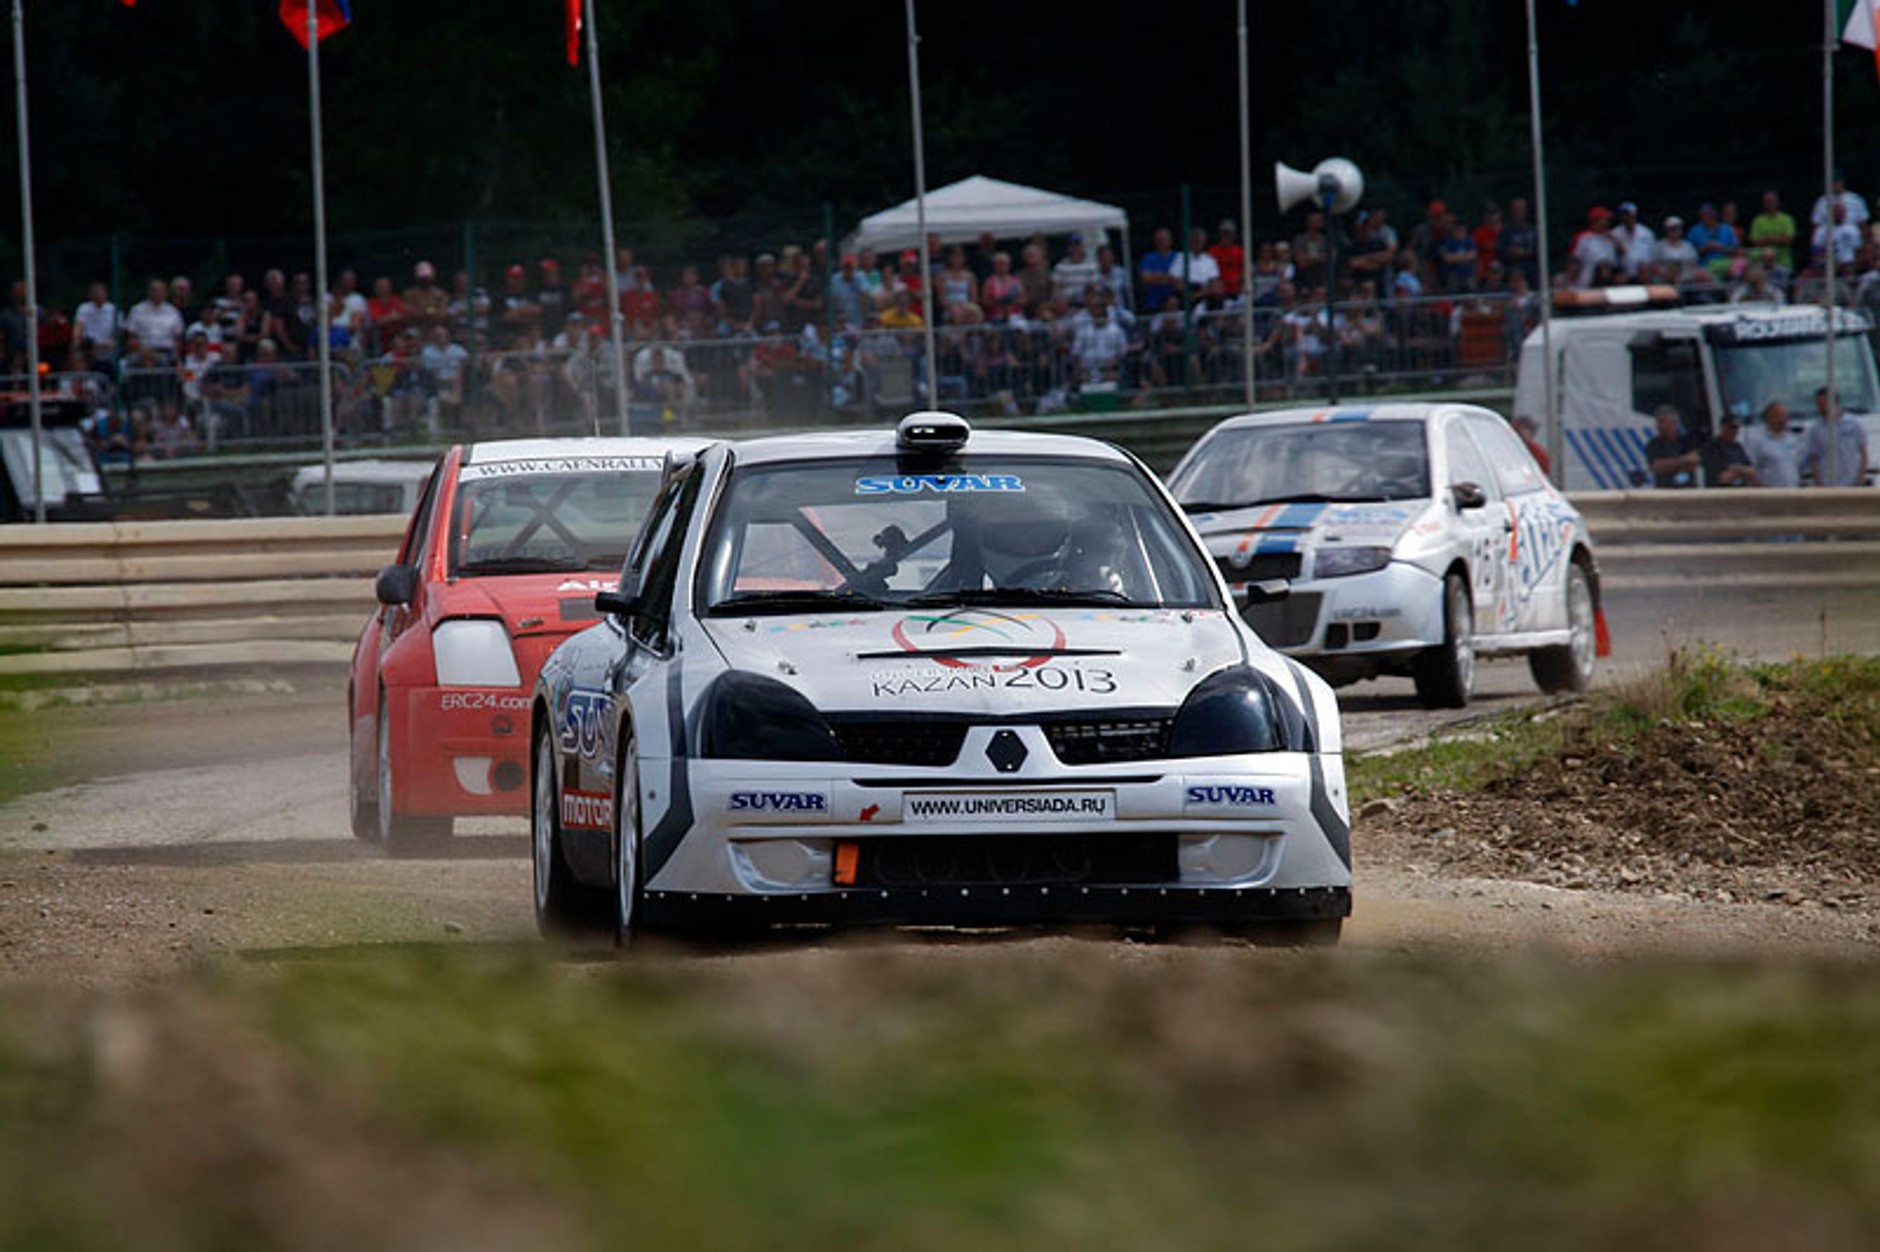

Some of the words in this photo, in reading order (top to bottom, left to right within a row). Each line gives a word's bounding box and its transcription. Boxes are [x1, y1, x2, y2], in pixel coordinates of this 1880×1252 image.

[855, 474, 1026, 494] SUVAR
[872, 674, 996, 697] KAZAN
[1005, 667, 1118, 694] 2013
[730, 792, 826, 811] SUVAR
[1186, 785, 1276, 805] SUVAR
[911, 798, 1106, 817] WWW.UNIVERSIADA.RU
